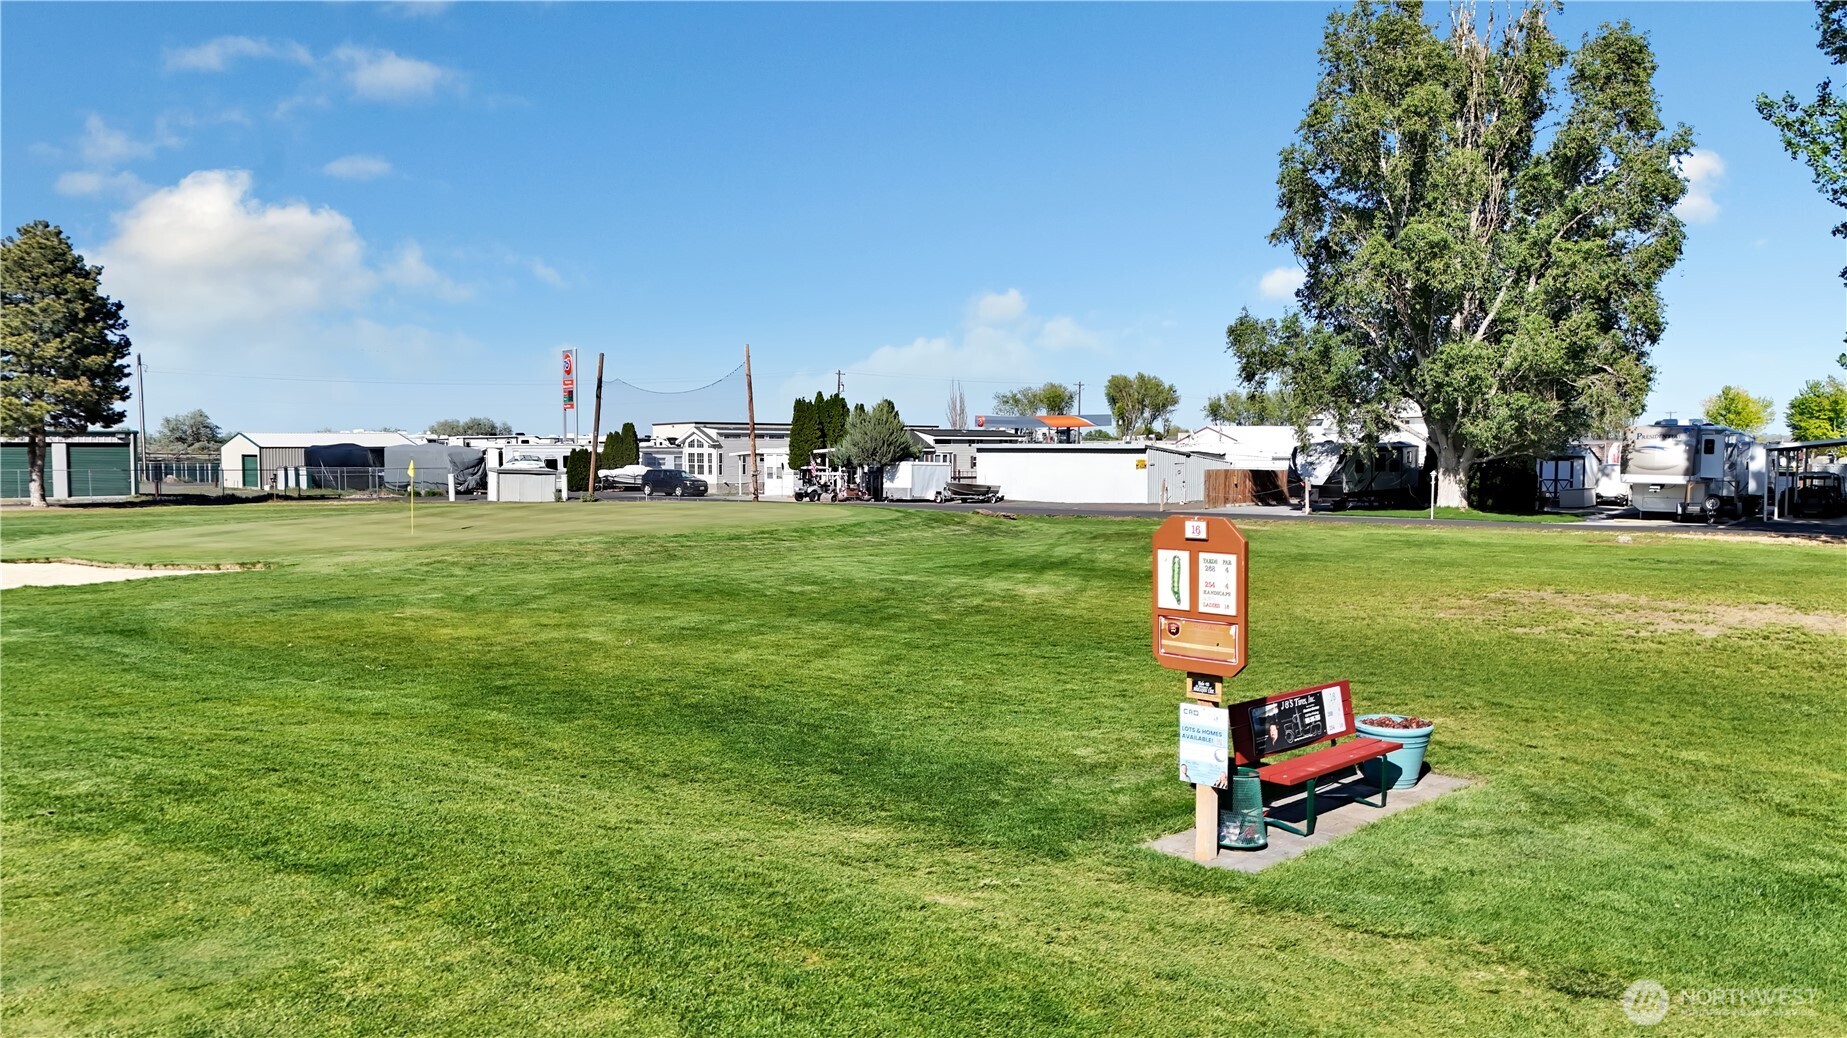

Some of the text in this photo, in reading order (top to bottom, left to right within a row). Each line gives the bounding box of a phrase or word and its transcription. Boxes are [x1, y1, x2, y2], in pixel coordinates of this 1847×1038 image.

[1191, 524, 1201, 535] 16
[1181, 725, 1196, 733] LOTS
[1202, 729, 1223, 738] HOMES
[1181, 733, 1214, 744] AVAILABLE!
